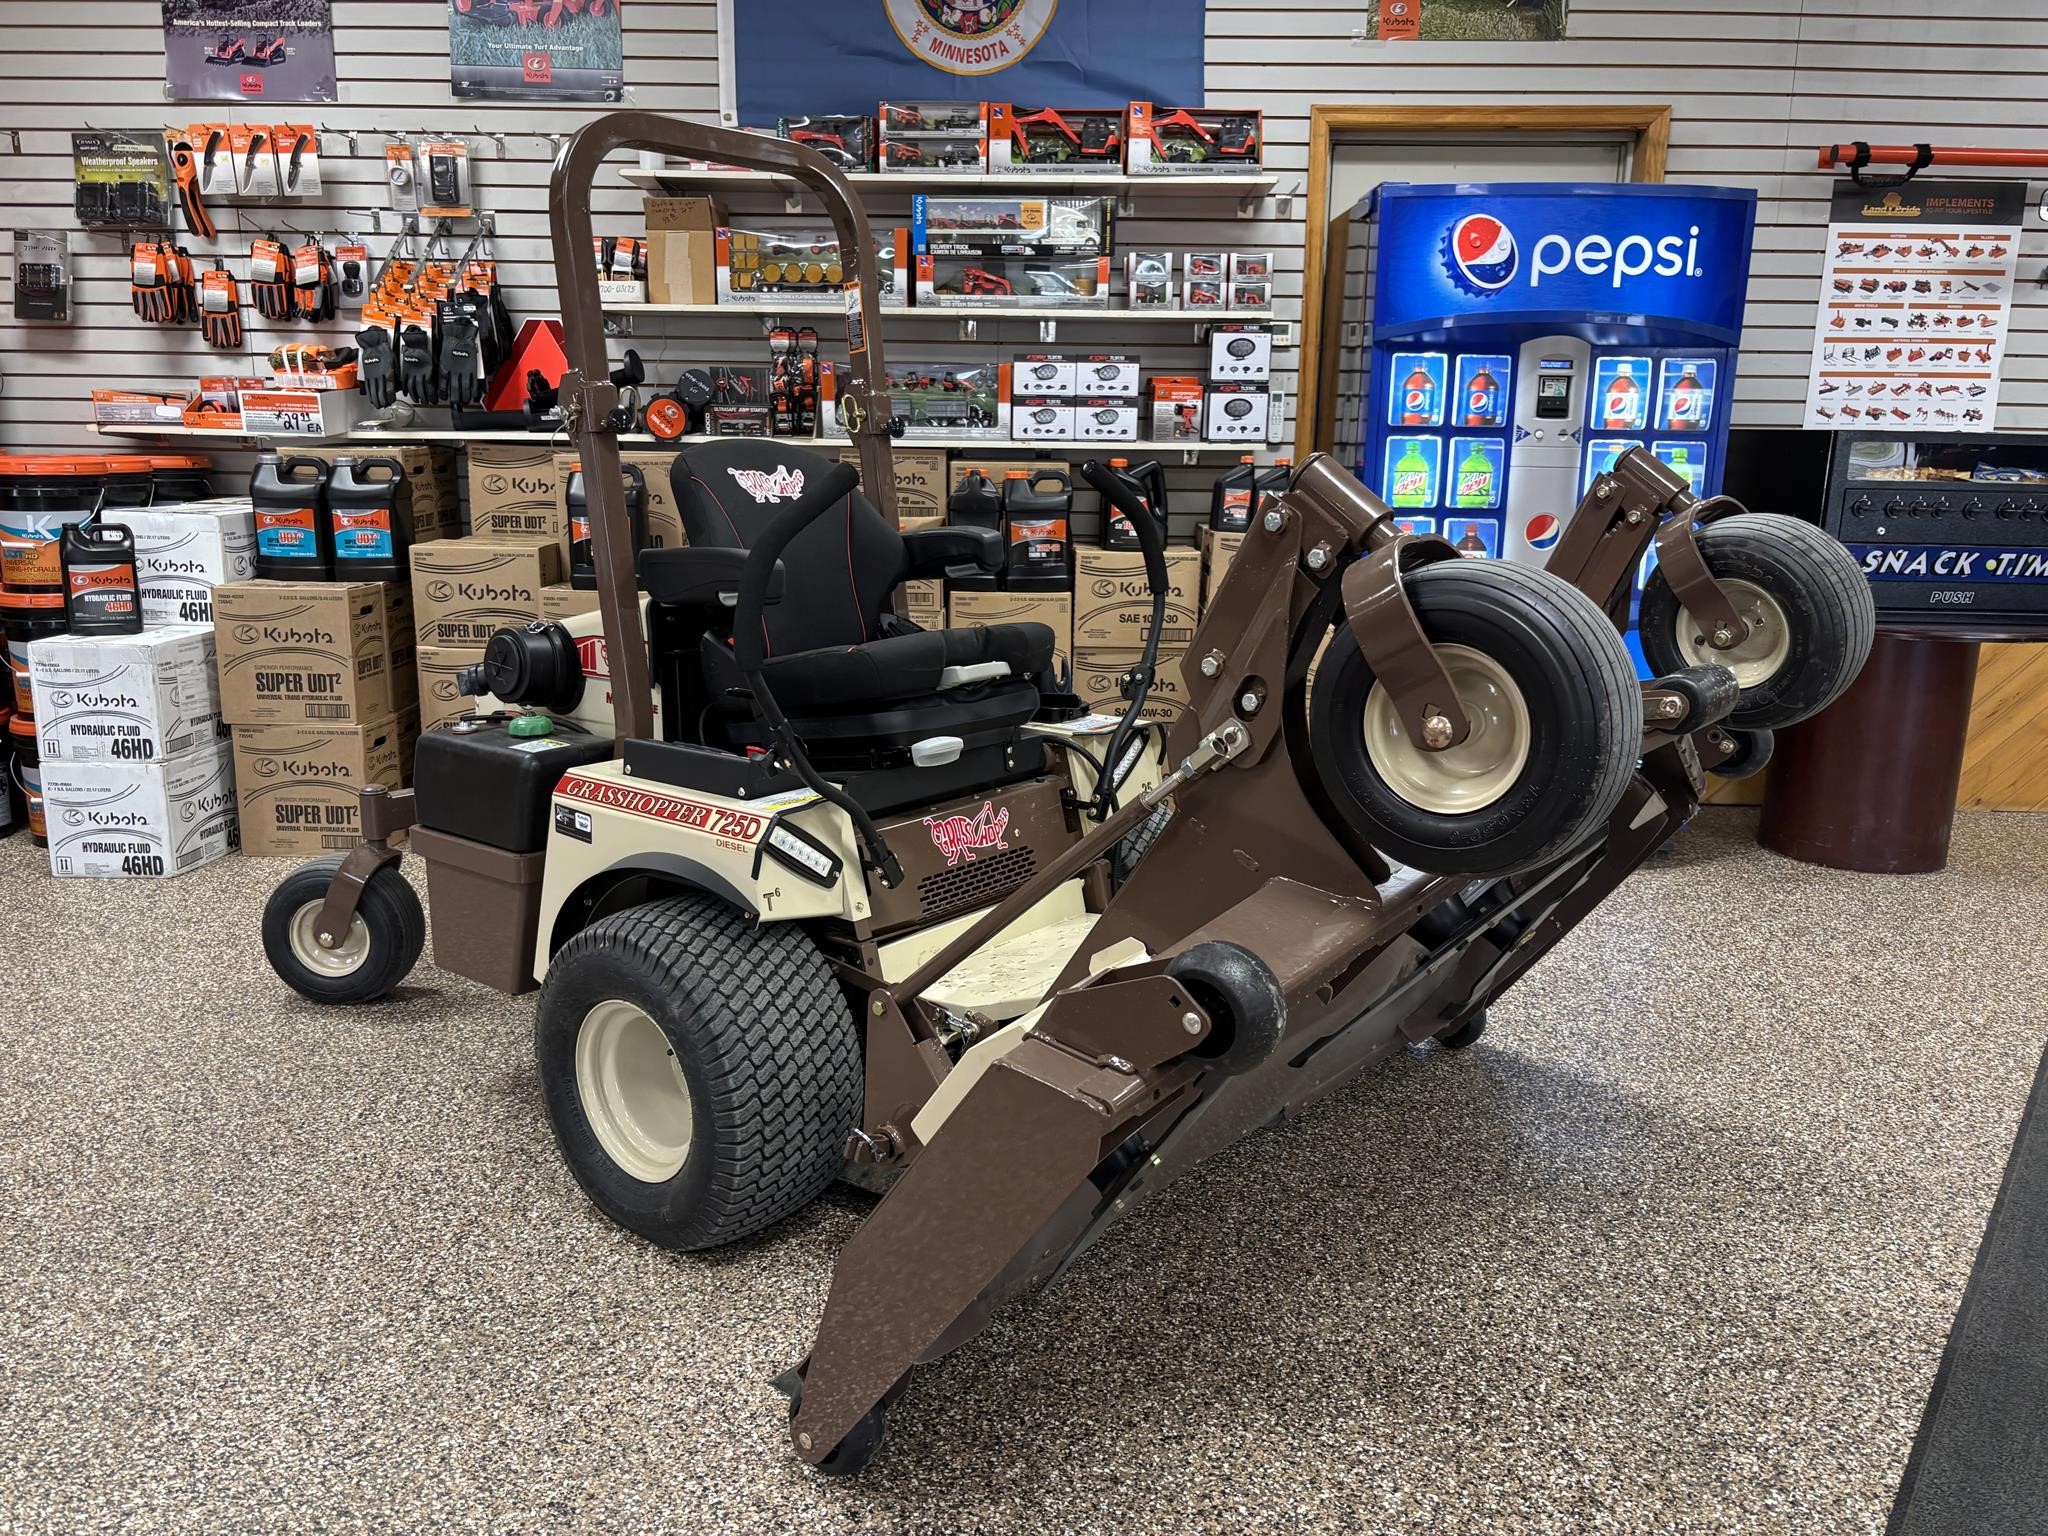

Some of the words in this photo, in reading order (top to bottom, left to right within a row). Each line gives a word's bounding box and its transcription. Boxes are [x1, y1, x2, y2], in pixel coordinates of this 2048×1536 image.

[173, 18, 205, 27] America's
[206, 19, 251, 28] Hottest-Selling
[252, 20, 279, 28] Compact
[279, 20, 296, 28] Track
[297, 20, 322, 28] Loaders
[1383, 17, 1415, 26] Kubota
[549, 44, 584, 52] Advantage
[928, 36, 1010, 65] MINNESOTA
[80, 156, 126, 167] Weatherproof
[127, 157, 159, 167] Speakers
[915, 196, 923, 225] Kubota
[1864, 204, 1889, 212] Land
[1895, 205, 1921, 213] Pride
[1925, 198, 1995, 208] IMPLEMENTS
[1530, 225, 1700, 288] pepsi
[731, 295, 756, 303] Kubota
[512, 477, 556, 494] Kub
[894, 472, 926, 485] bota
[275, 517, 304, 525] Kubota
[353, 517, 380, 526] Kubota
[491, 514, 522, 529] SUPER
[1031, 528, 1056, 536] Kubota
[147, 558, 205, 573] Kubota
[1861, 549, 1981, 576] SNACK
[91, 576, 131, 585] Kubota
[141, 588, 184, 600] HYDRAULIC
[185, 590, 208, 600] FLUID
[458, 583, 532, 601] Kubota
[1119, 582, 1182, 598] Kuba
[1930, 591, 1975, 604] PUSH
[84, 594, 115, 603] HYDRAULIC
[104, 601, 133, 613] 46HD
[1119, 613, 1140, 623] SAE
[1143, 614, 1178, 623] 10-30
[264, 627, 333, 644] Kubota
[437, 623, 470, 638] SUPER
[255, 672, 304, 693] SUPER
[76, 692, 137, 707] Kubota
[70, 724, 116, 736] HYDRAULIC
[117, 725, 141, 737] FLUID
[111, 738, 154, 760] 46HD
[376, 751, 397, 765] Kubota
[283, 760, 350, 777] Kubota
[275, 804, 322, 825] SUPER
[566, 779, 707, 825] GRASSHOPPER
[708, 809, 762, 840] 725D
[88, 811, 148, 826] Kubota
[199, 822, 224, 841] HYDRAULIC
[224, 817, 237, 831] FLUID
[227, 828, 240, 849] 46
[715, 838, 749, 854] DIESEL
[82, 842, 127, 854] HYDRAULIC
[128, 842, 151, 854] FLUID
[121, 855, 165, 876] 46HD
